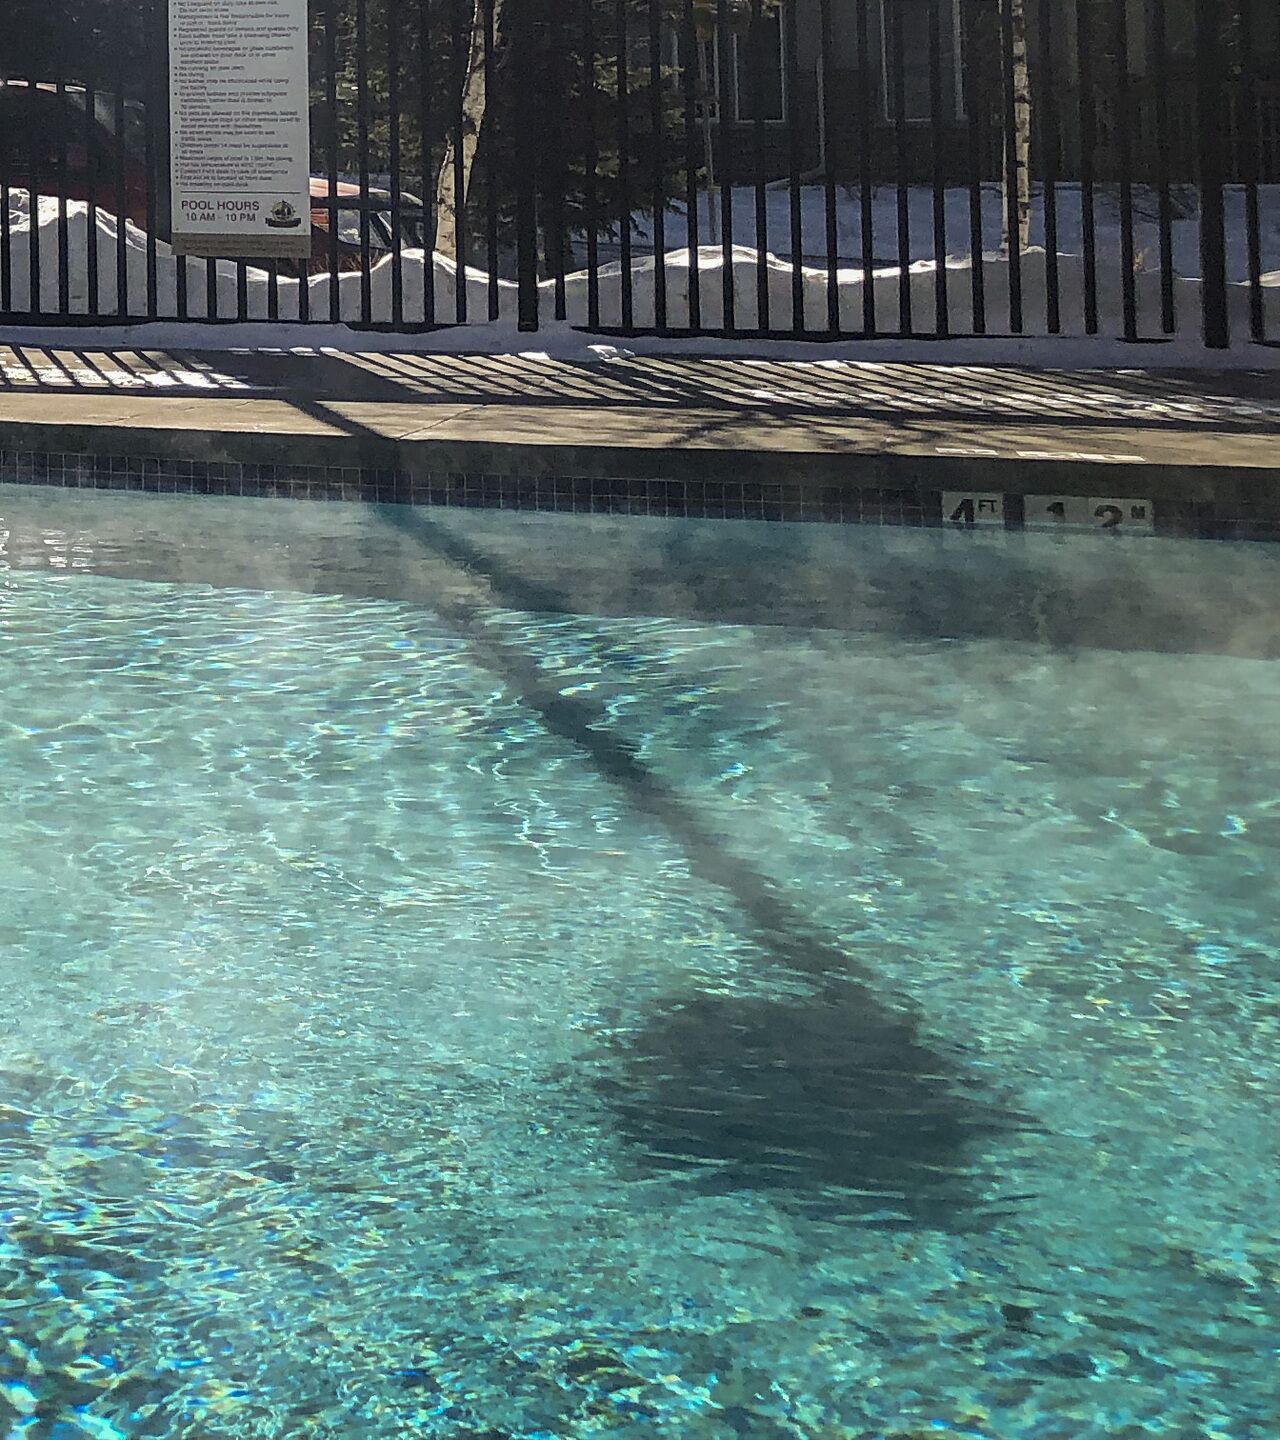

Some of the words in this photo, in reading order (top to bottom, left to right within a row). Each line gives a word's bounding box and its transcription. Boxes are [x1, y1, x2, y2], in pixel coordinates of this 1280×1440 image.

[181, 200, 216, 211] POOL
[217, 200, 260, 211] HOURS
[186, 213, 197, 222] 10
[199, 213, 216, 222] AM
[226, 213, 237, 222] 10
[239, 213, 256, 222] PM
[978, 499, 997, 513] FT
